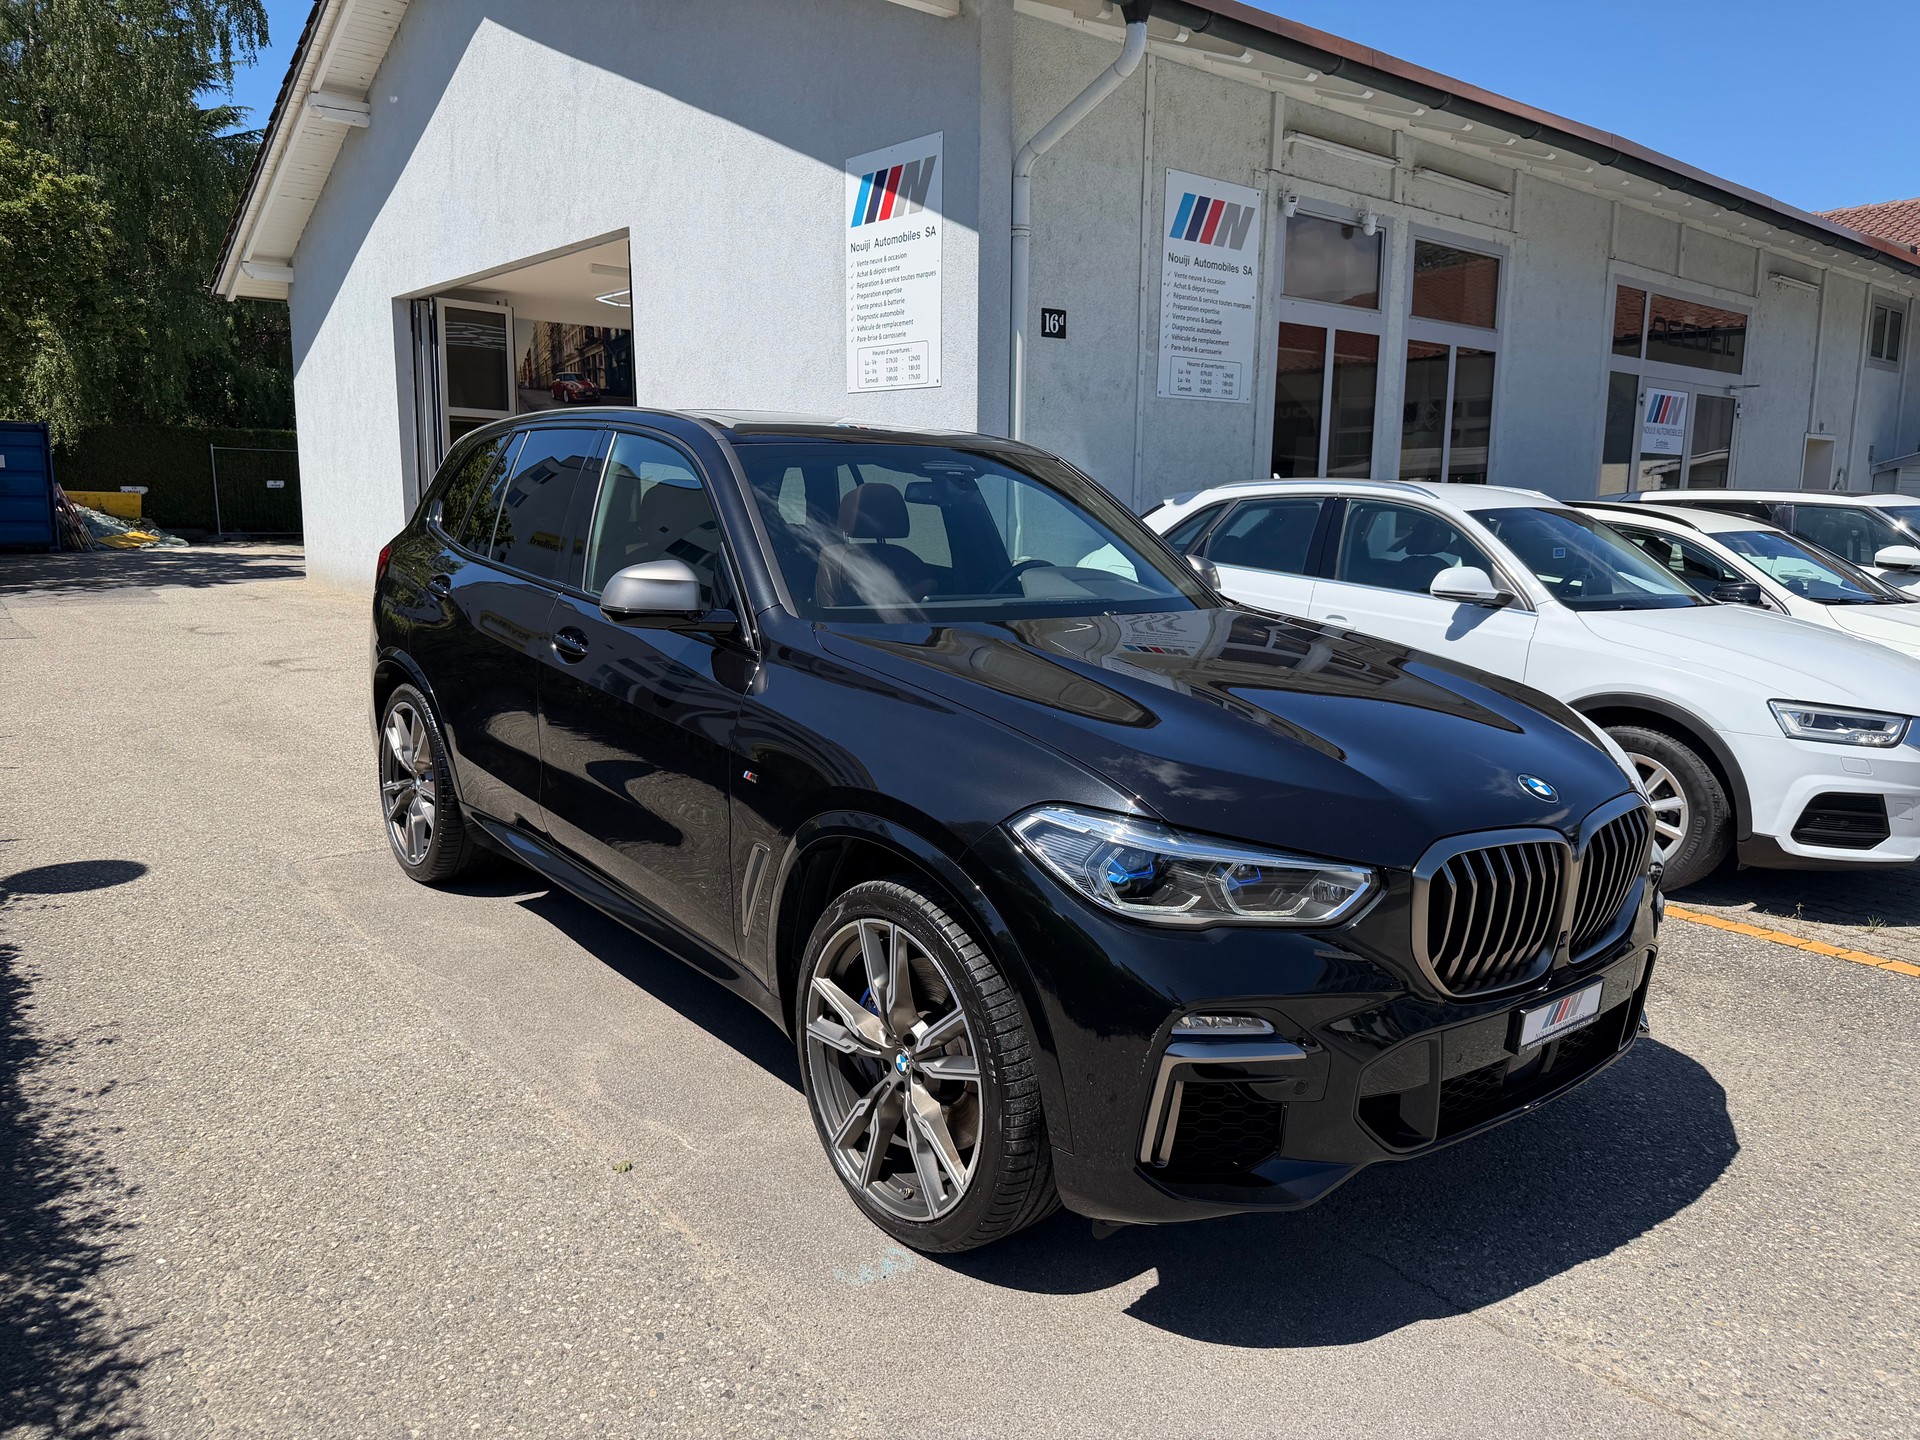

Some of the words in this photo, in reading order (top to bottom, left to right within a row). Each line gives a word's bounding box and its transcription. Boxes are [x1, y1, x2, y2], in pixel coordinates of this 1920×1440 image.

[850, 240, 871, 254] Nouiji
[874, 230, 921, 249] Automobiles
[925, 226, 936, 238] SA
[888, 252, 907, 262] occasion
[1168, 252, 1191, 267] Nouiji
[1194, 257, 1239, 274] Automobiles
[1242, 265, 1253, 276] SA
[856, 270, 869, 278] Achat
[900, 274, 915, 282] toutes
[916, 270, 936, 280] marques
[1174, 272, 1187, 280] Vente
[1207, 278, 1226, 286] occasion
[882, 287, 902, 297] expertise
[1174, 282, 1186, 290] Achat
[870, 301, 883, 310] pneus
[888, 298, 905, 306] batterie
[1203, 298, 1218, 306] service
[1233, 302, 1252, 310] marques
[857, 313, 879, 322] Diagnostic
[880, 308, 905, 318] automobile
[1200, 307, 1220, 316] expertise
[876, 322, 881, 330] de
[882, 319, 914, 330] remplacement
[1172, 313, 1186, 321] Vente
[1205, 317, 1222, 326] batterie
[883, 331, 906, 340] carrosserie
[1172, 323, 1196, 333] Diagnostic
[1196, 327, 1222, 336] automobile
[1198, 337, 1230, 346] remplacement
[1171, 344, 1193, 352] Pare-brise
[1199, 348, 1222, 356] carrosserie
